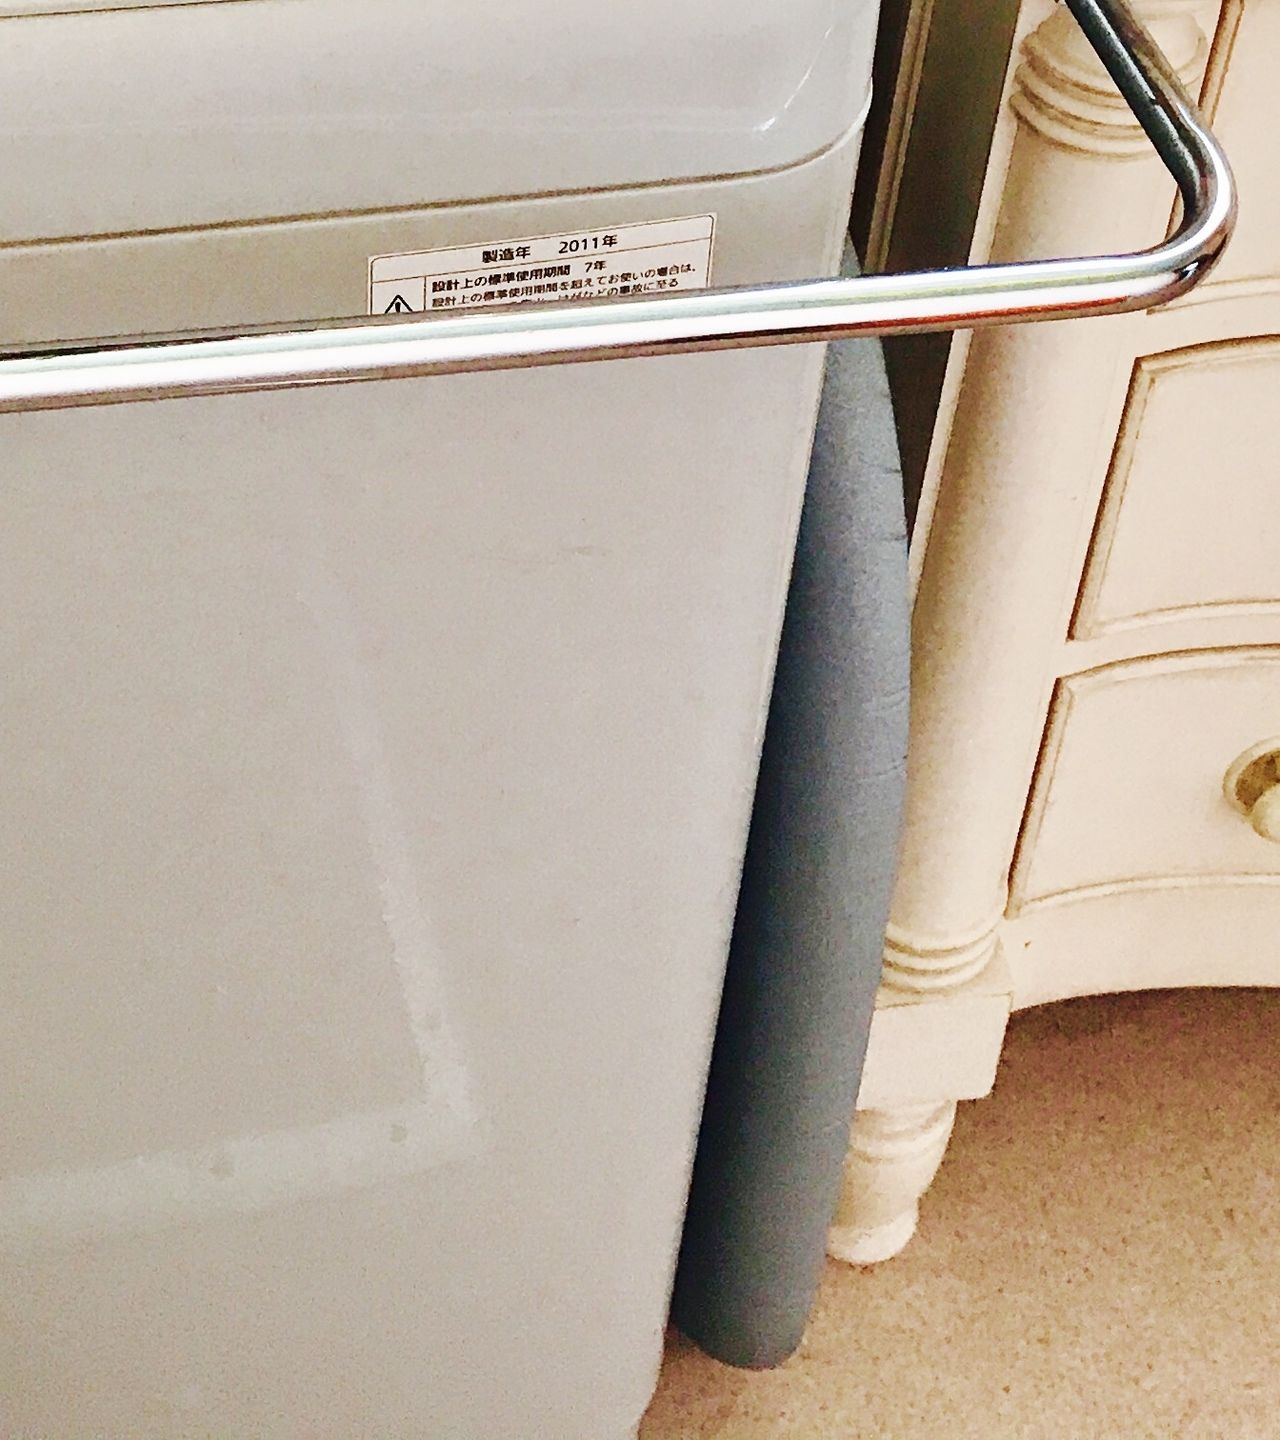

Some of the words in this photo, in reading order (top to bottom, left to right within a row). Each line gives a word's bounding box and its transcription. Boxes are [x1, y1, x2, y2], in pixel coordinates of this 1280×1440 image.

[482, 245, 532, 264] 製造年
[557, 233, 620, 255] 2011年
[431, 264, 572, 294] 設計上の標準使用期間
[584, 260, 608, 274] 7年
